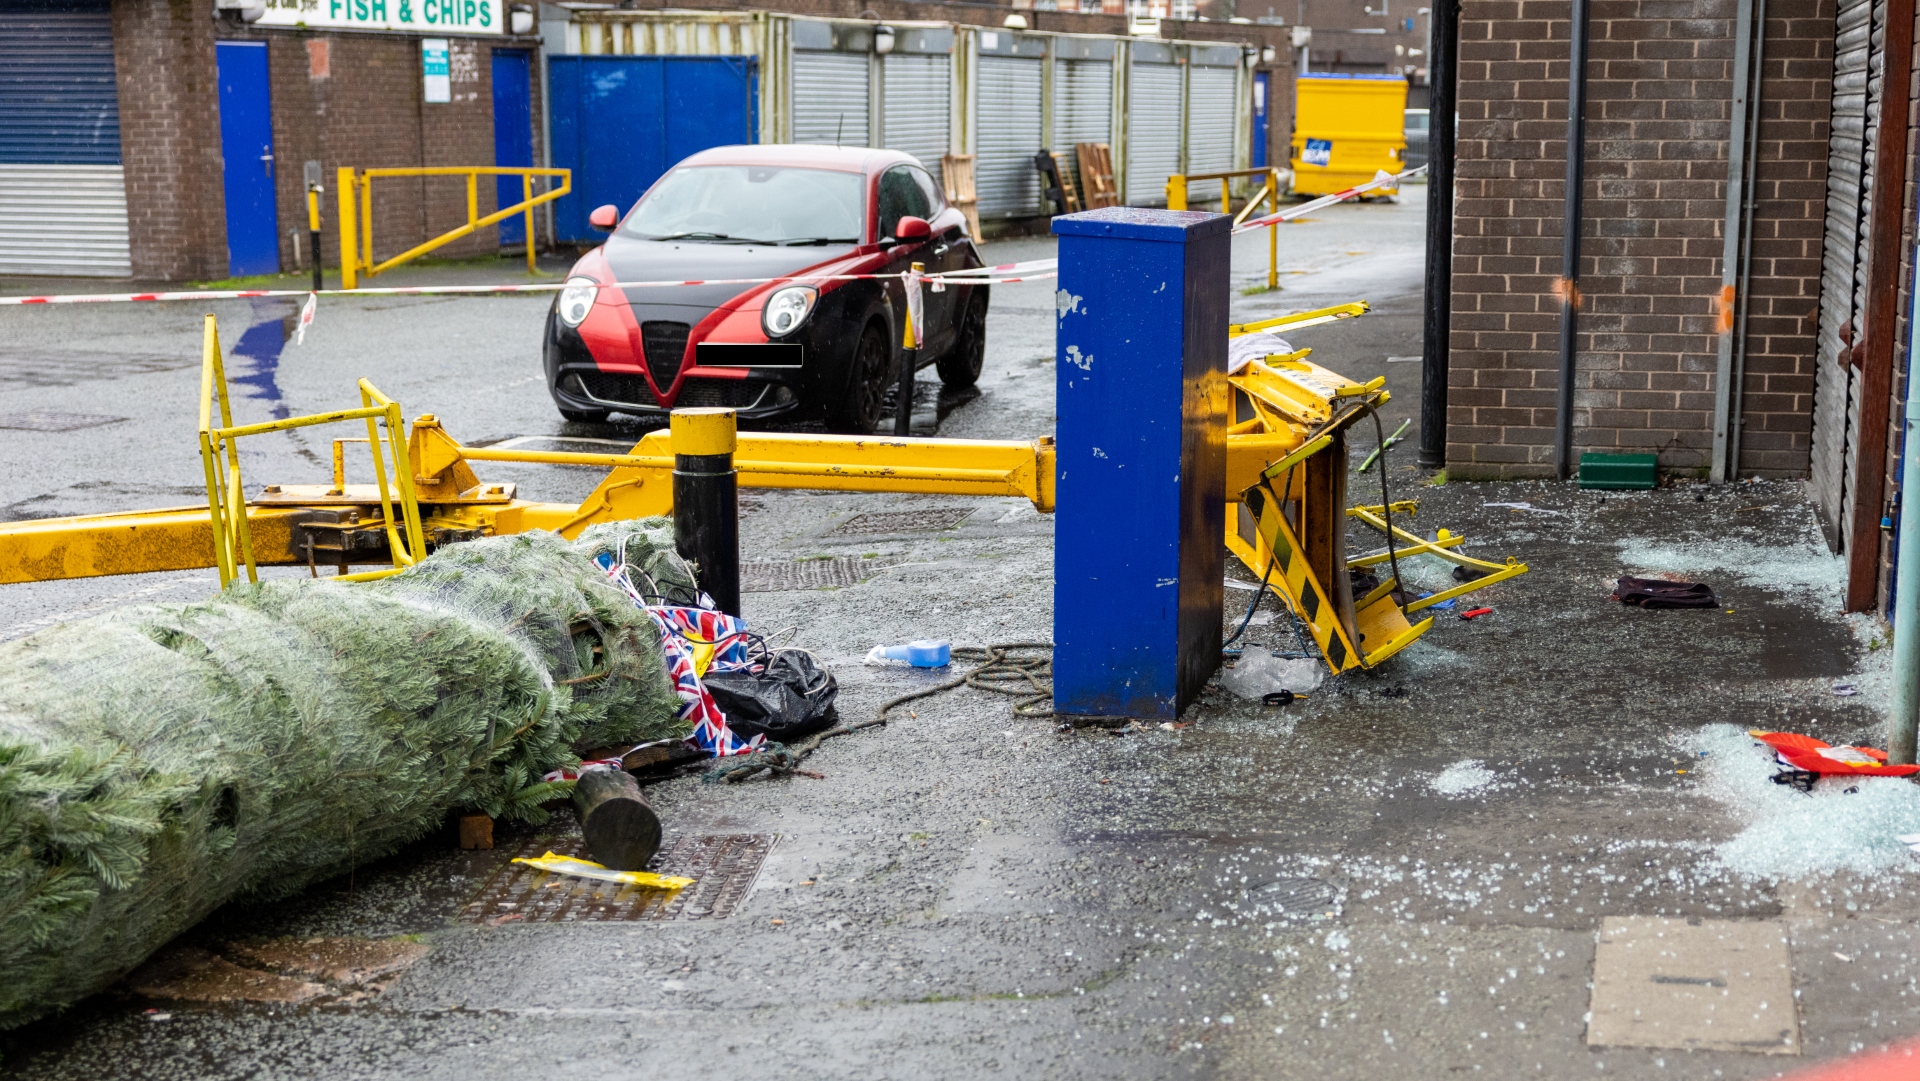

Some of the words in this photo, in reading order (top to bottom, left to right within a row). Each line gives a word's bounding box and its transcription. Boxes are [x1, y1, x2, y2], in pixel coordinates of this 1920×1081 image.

[330, 0, 386, 21] FISH
[399, 0, 413, 23] &
[424, 0, 492, 27] CHIPS
